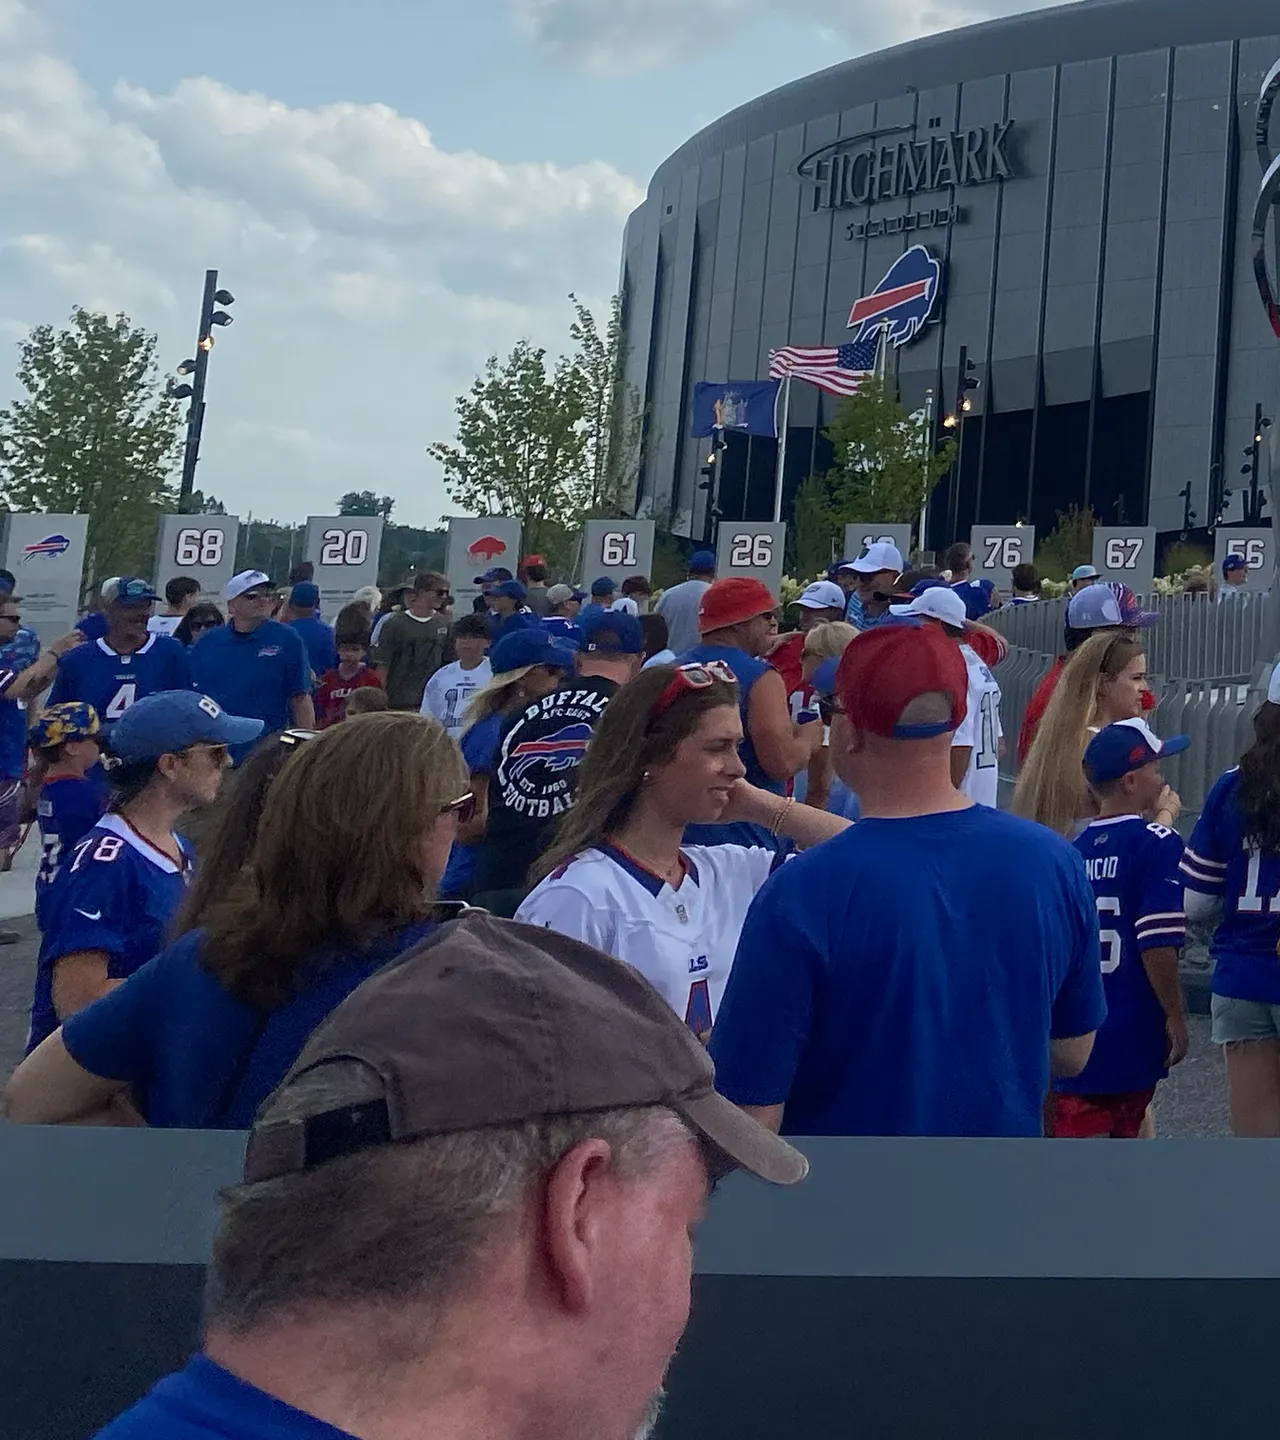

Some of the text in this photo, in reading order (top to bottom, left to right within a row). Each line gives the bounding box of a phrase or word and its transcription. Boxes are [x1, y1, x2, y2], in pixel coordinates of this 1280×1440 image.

[798, 119, 1015, 211] HIGHMARK
[175, 528, 225, 566] 68
[321, 529, 369, 565] 20
[602, 532, 637, 566] 61
[730, 533, 773, 567] 26
[983, 536, 1023, 568] 76
[1105, 537, 1145, 569] 67
[1227, 538, 1265, 569] 56
[106, 684, 135, 718] 4
[525, 690, 609, 720] BUFFAL
[503, 783, 575, 817] FOOTBAL
[542, 779, 567, 794] 1960
[1095, 896, 1121, 974] 6
